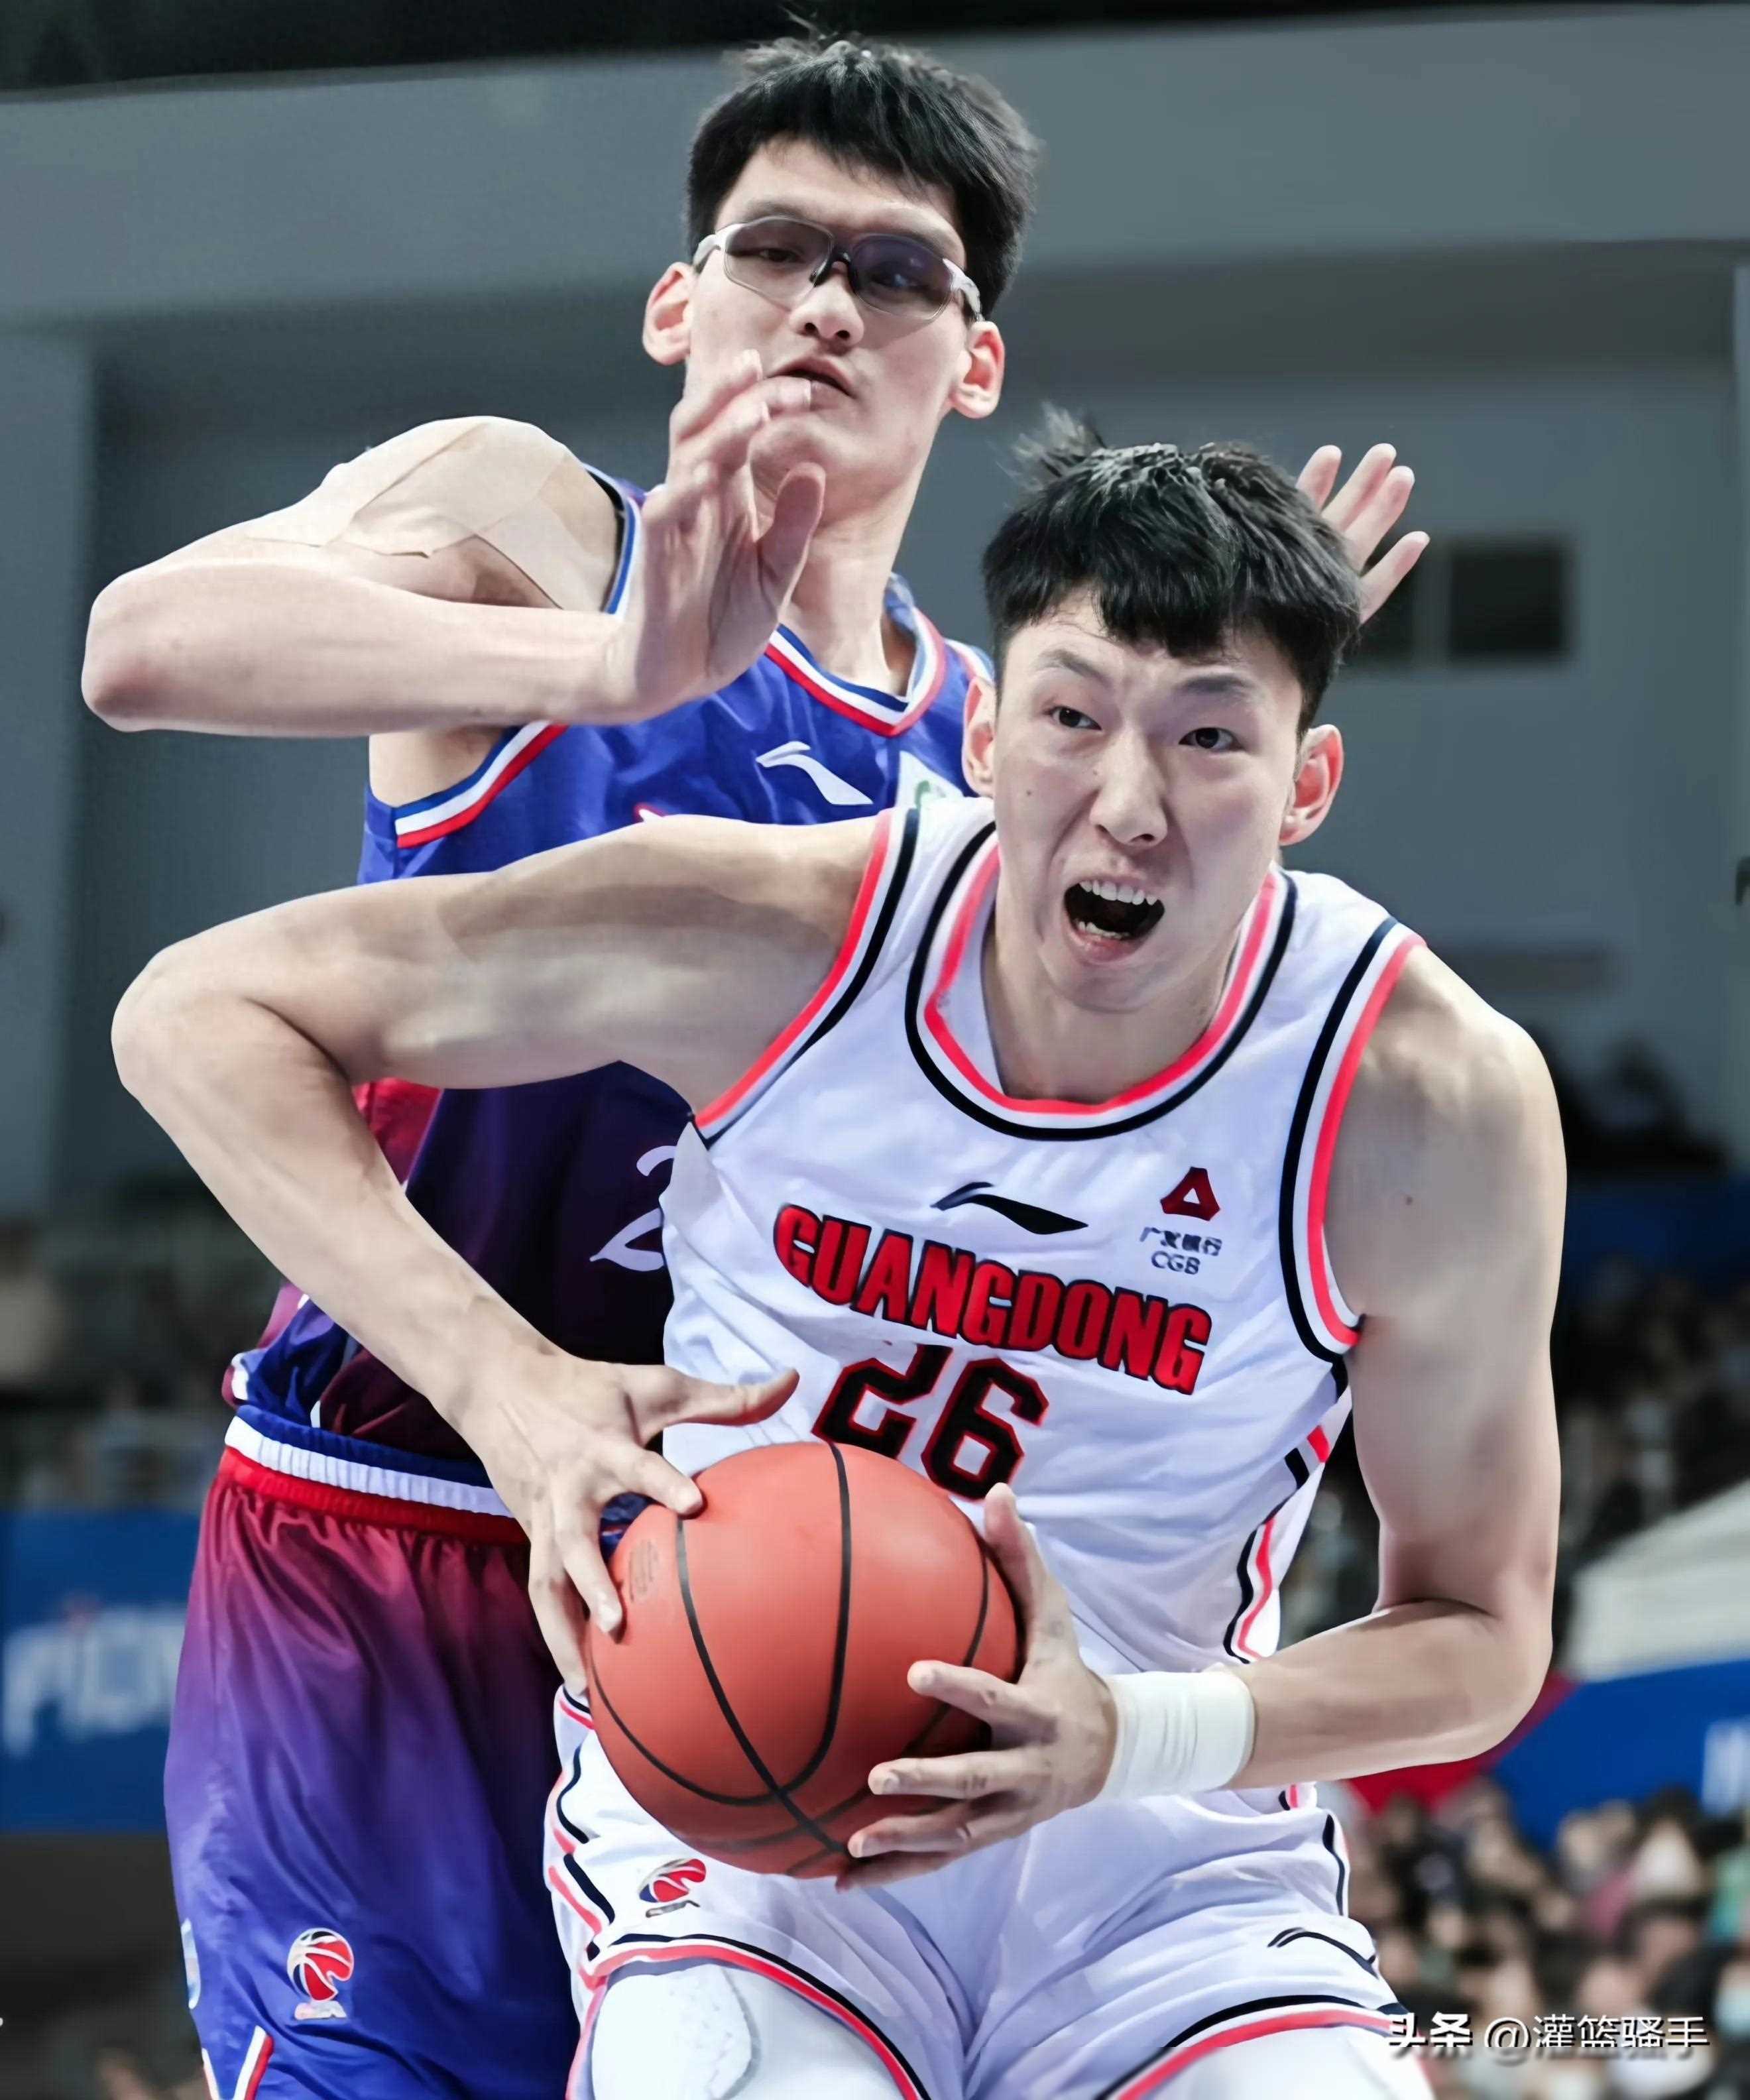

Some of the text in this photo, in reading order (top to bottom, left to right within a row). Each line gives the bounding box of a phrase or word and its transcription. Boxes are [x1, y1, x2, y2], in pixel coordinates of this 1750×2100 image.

[772, 1202, 1212, 1395] GUANGDONG
[1151, 1250, 1201, 1275] CGB
[813, 1344, 1049, 1501] 26
